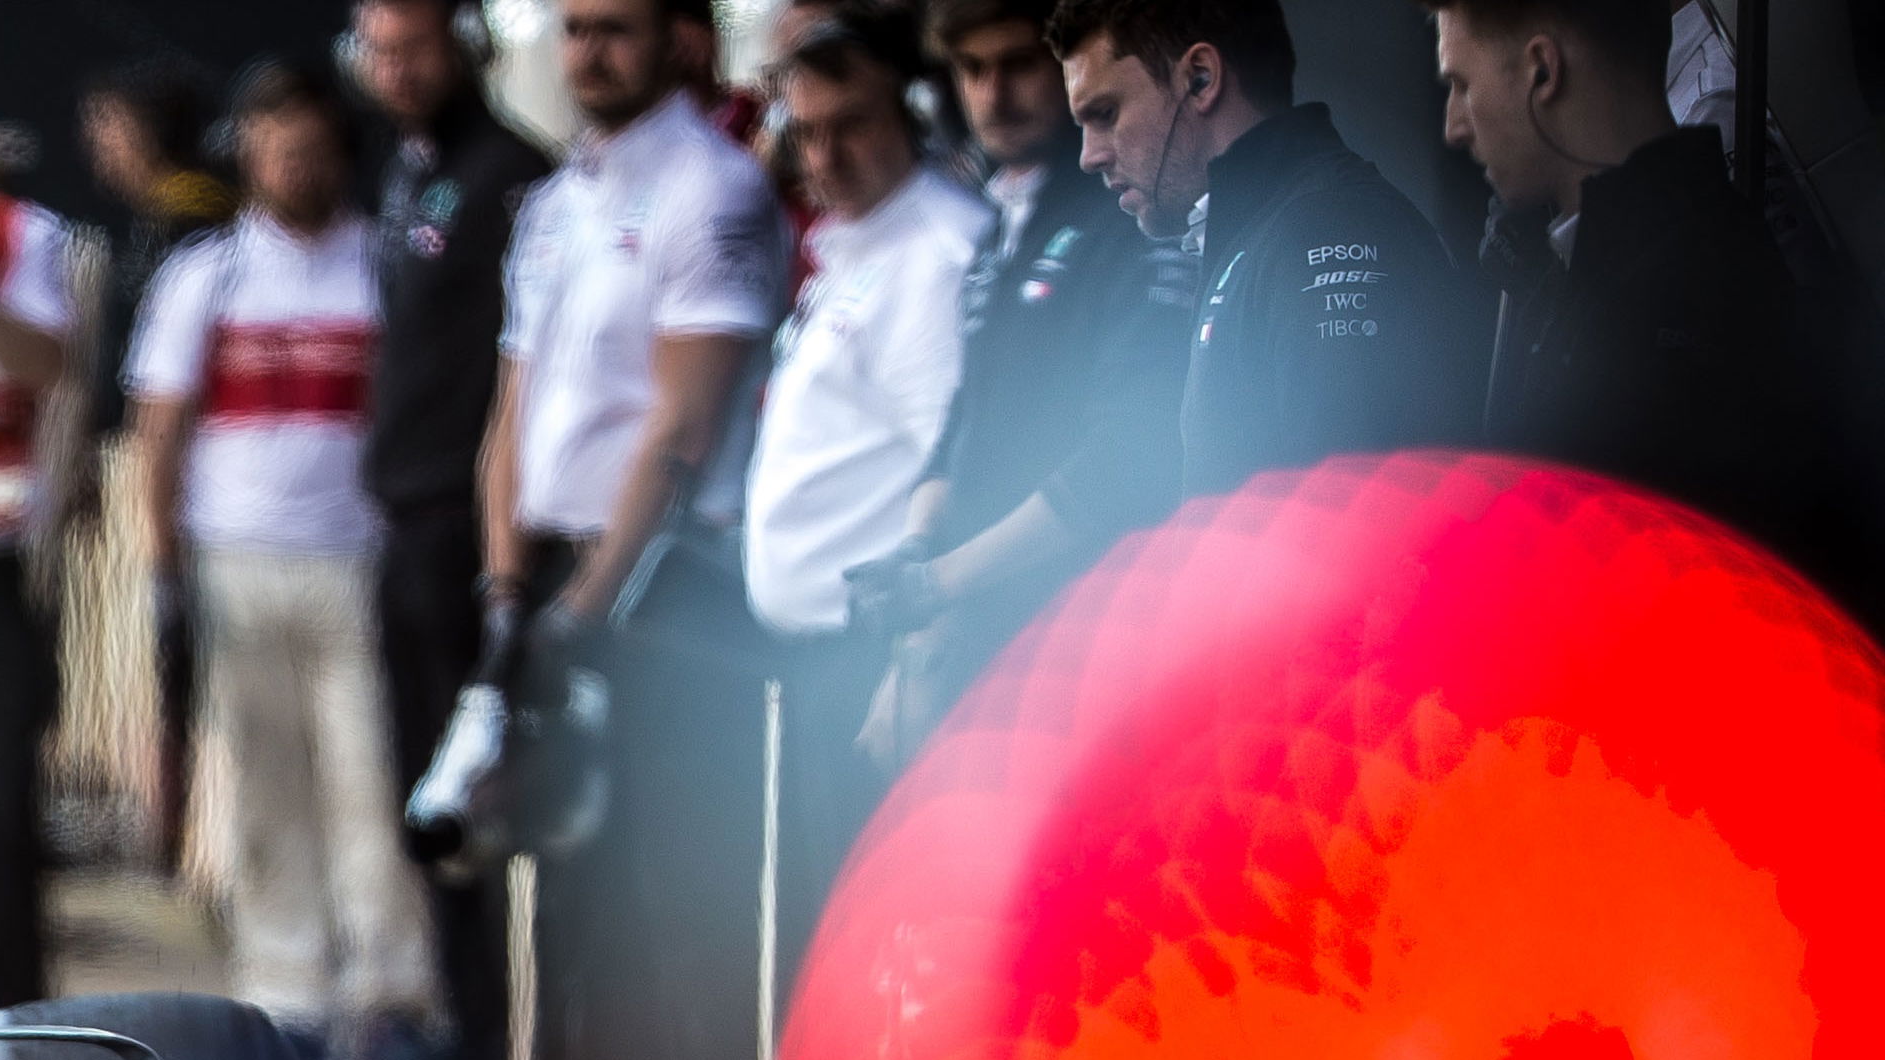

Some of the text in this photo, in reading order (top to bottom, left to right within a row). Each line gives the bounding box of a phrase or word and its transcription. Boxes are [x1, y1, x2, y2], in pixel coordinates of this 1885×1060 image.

[1308, 244, 1377, 265] EPSON
[1301, 270, 1388, 291] BOSE
[1325, 293, 1367, 311] IWC
